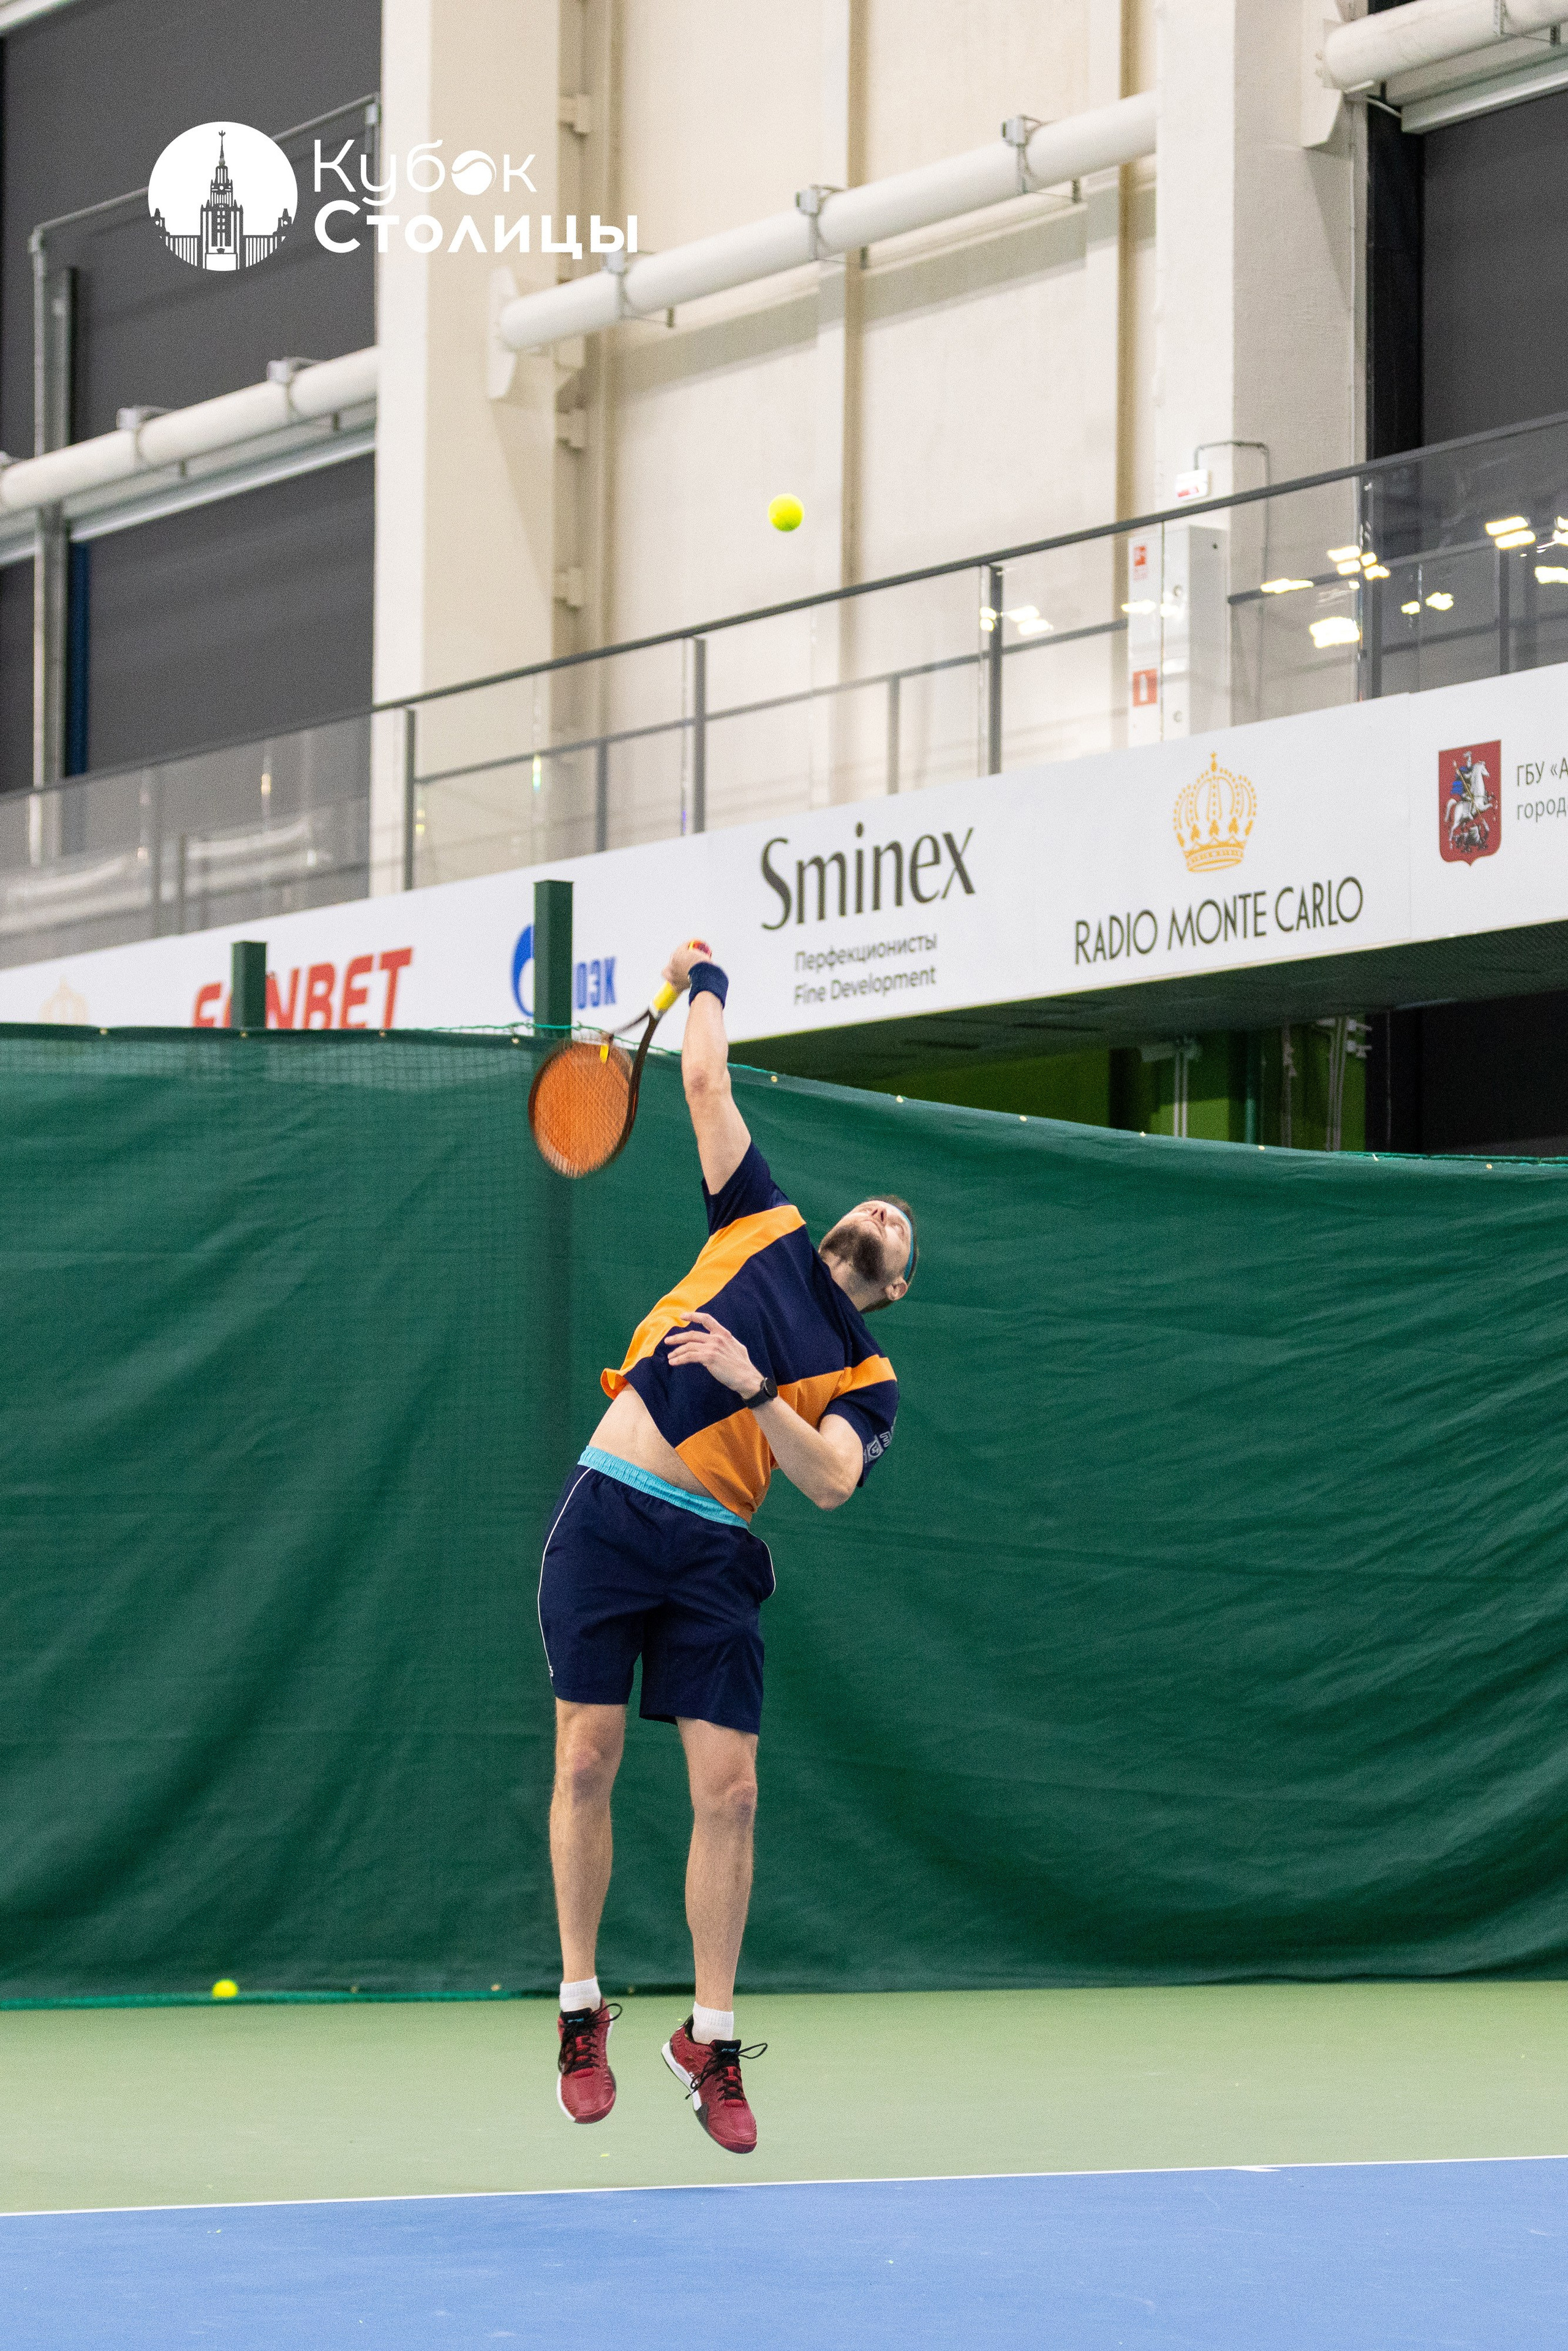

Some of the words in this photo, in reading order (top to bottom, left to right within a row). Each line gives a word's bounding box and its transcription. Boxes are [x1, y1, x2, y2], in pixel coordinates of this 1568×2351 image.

[1517, 761, 1545, 787] ГБУ
[761, 821, 976, 930] Sminex
[1075, 909, 1158, 965] RADIO
[1167, 890, 1267, 950] MONTE
[1275, 876, 1363, 932] CARLO
[794, 933, 937, 973] Перфекционисты
[192, 946, 413, 1028] FNBET
[794, 983, 826, 1005] Fine
[831, 965, 937, 1000] Development
